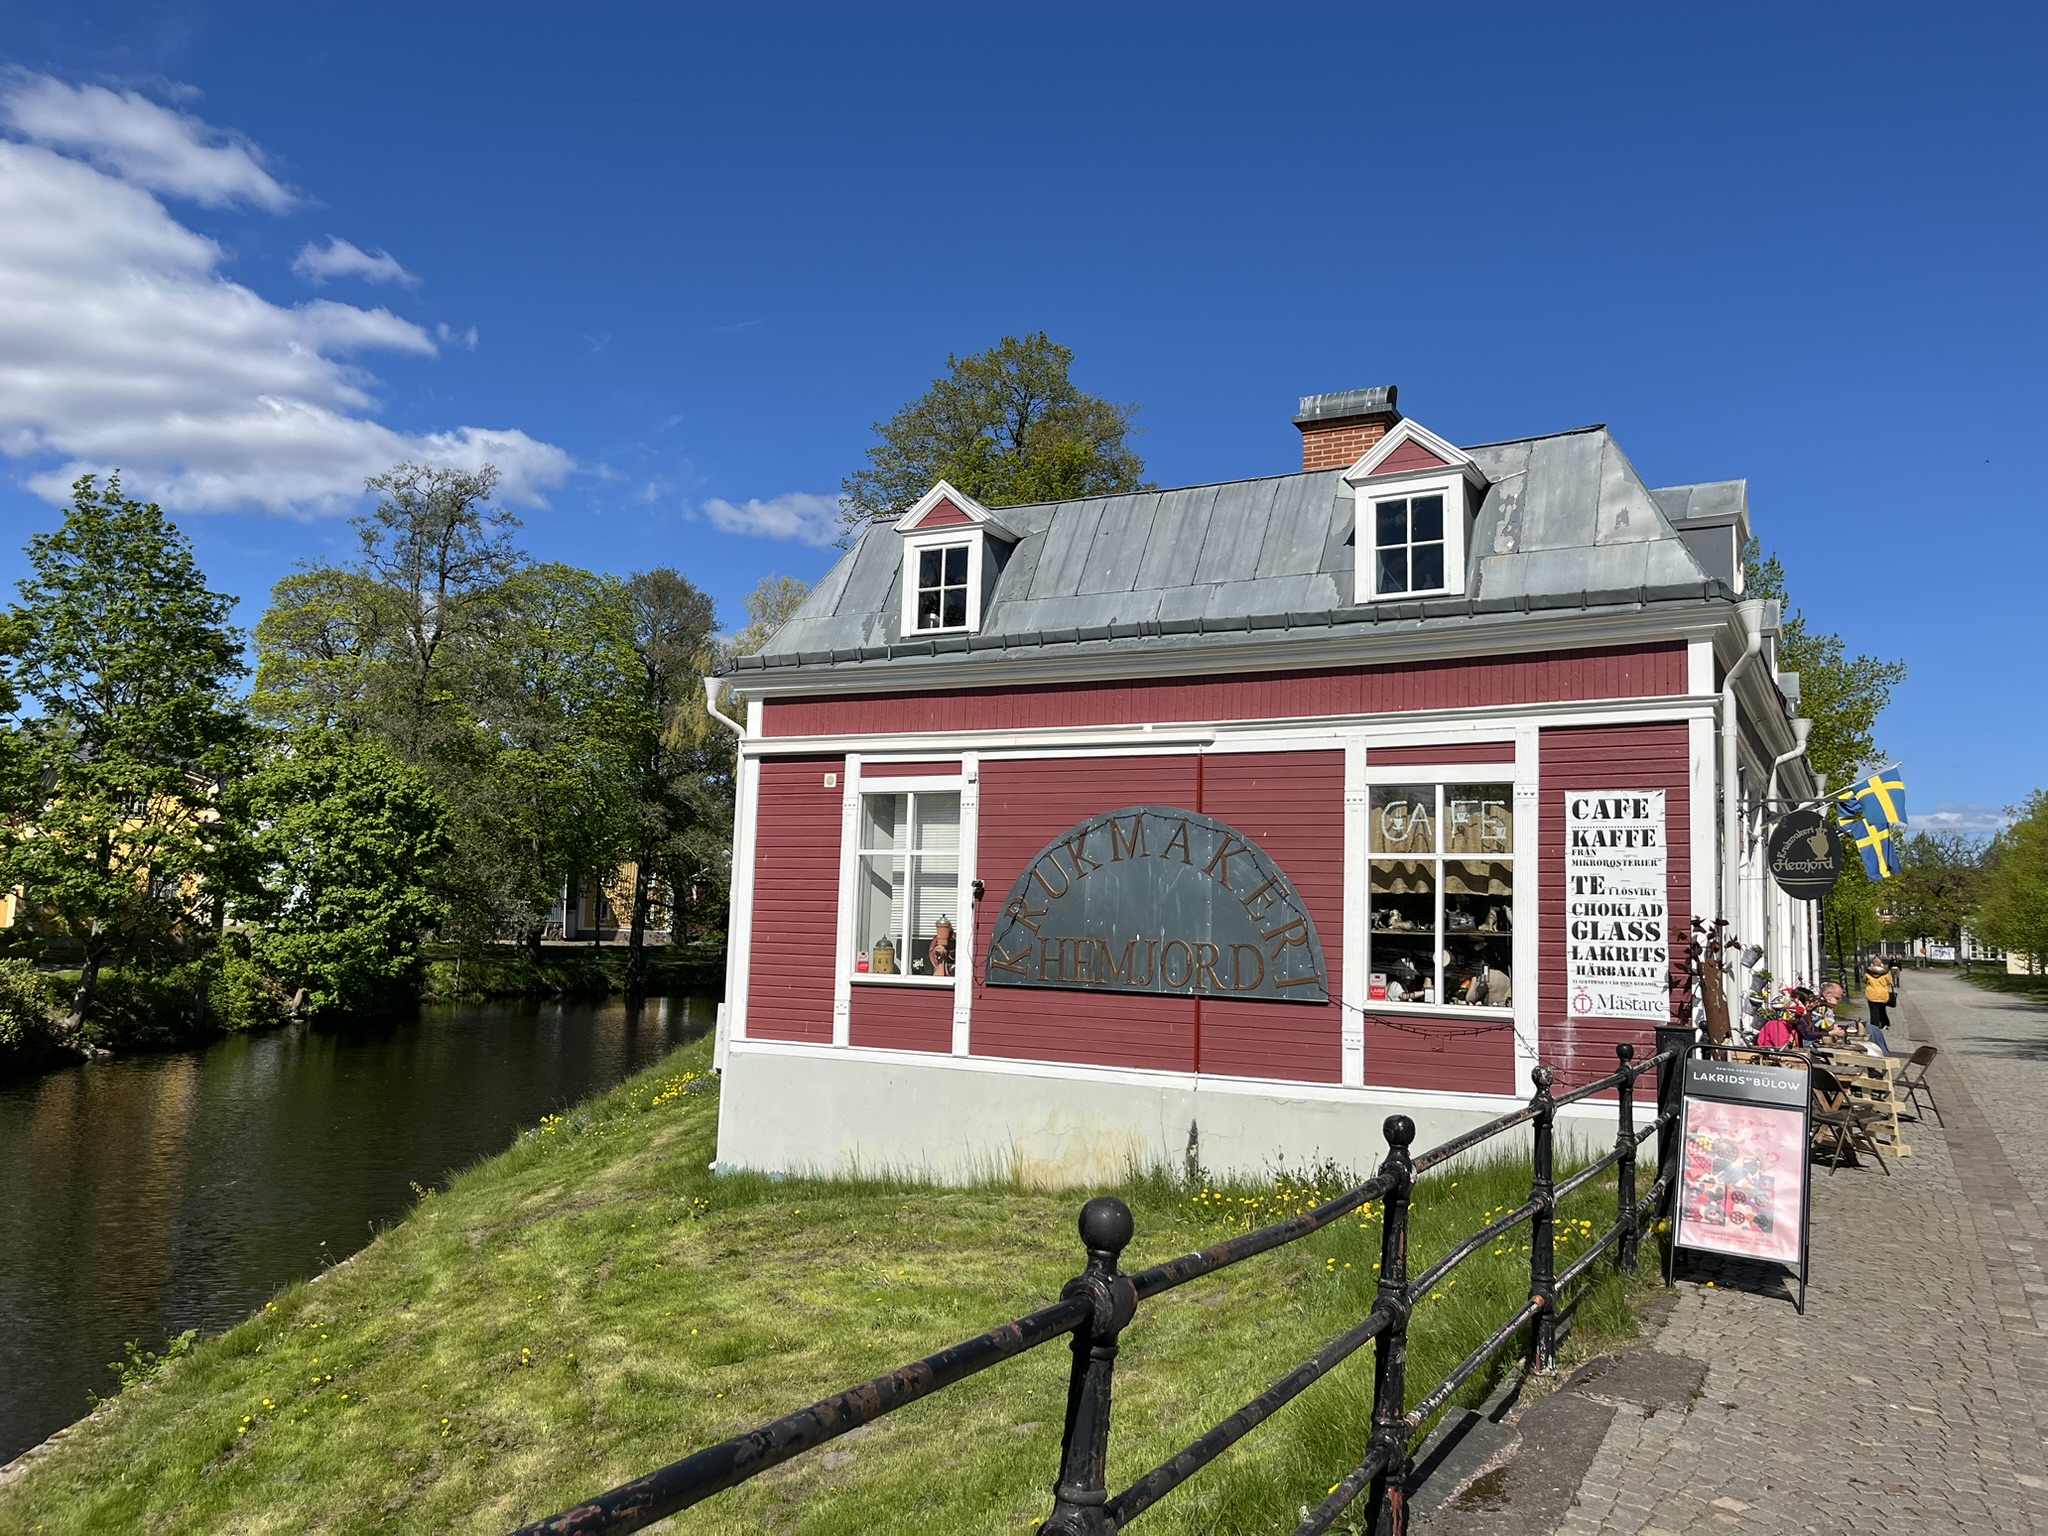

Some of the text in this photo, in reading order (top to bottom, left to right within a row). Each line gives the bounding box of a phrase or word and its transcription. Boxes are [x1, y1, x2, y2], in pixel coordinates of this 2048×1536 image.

[1571, 798, 1649, 820] CAFE
[1382, 800, 1506, 841] CAFE
[1571, 829, 1656, 847] KAFFE
[1571, 847, 1597, 856] FRÅN
[1773, 857, 1834, 873] Hemjord
[1571, 875, 1605, 895] TE
[1615, 886, 1657, 896] LÖSVIKT
[992, 813, 1321, 992] KRUKMAKERI
[1571, 903, 1663, 917] CHOKLAD
[1571, 920, 1661, 941] GLASS
[1571, 945, 1666, 962] LAKRITS
[1036, 936, 1265, 992] HEMJORD
[1597, 993, 1664, 1012] Mästare
[1693, 1072, 1745, 1085] LAKRIDS
[1753, 1078, 1800, 1091] BÜLOW
